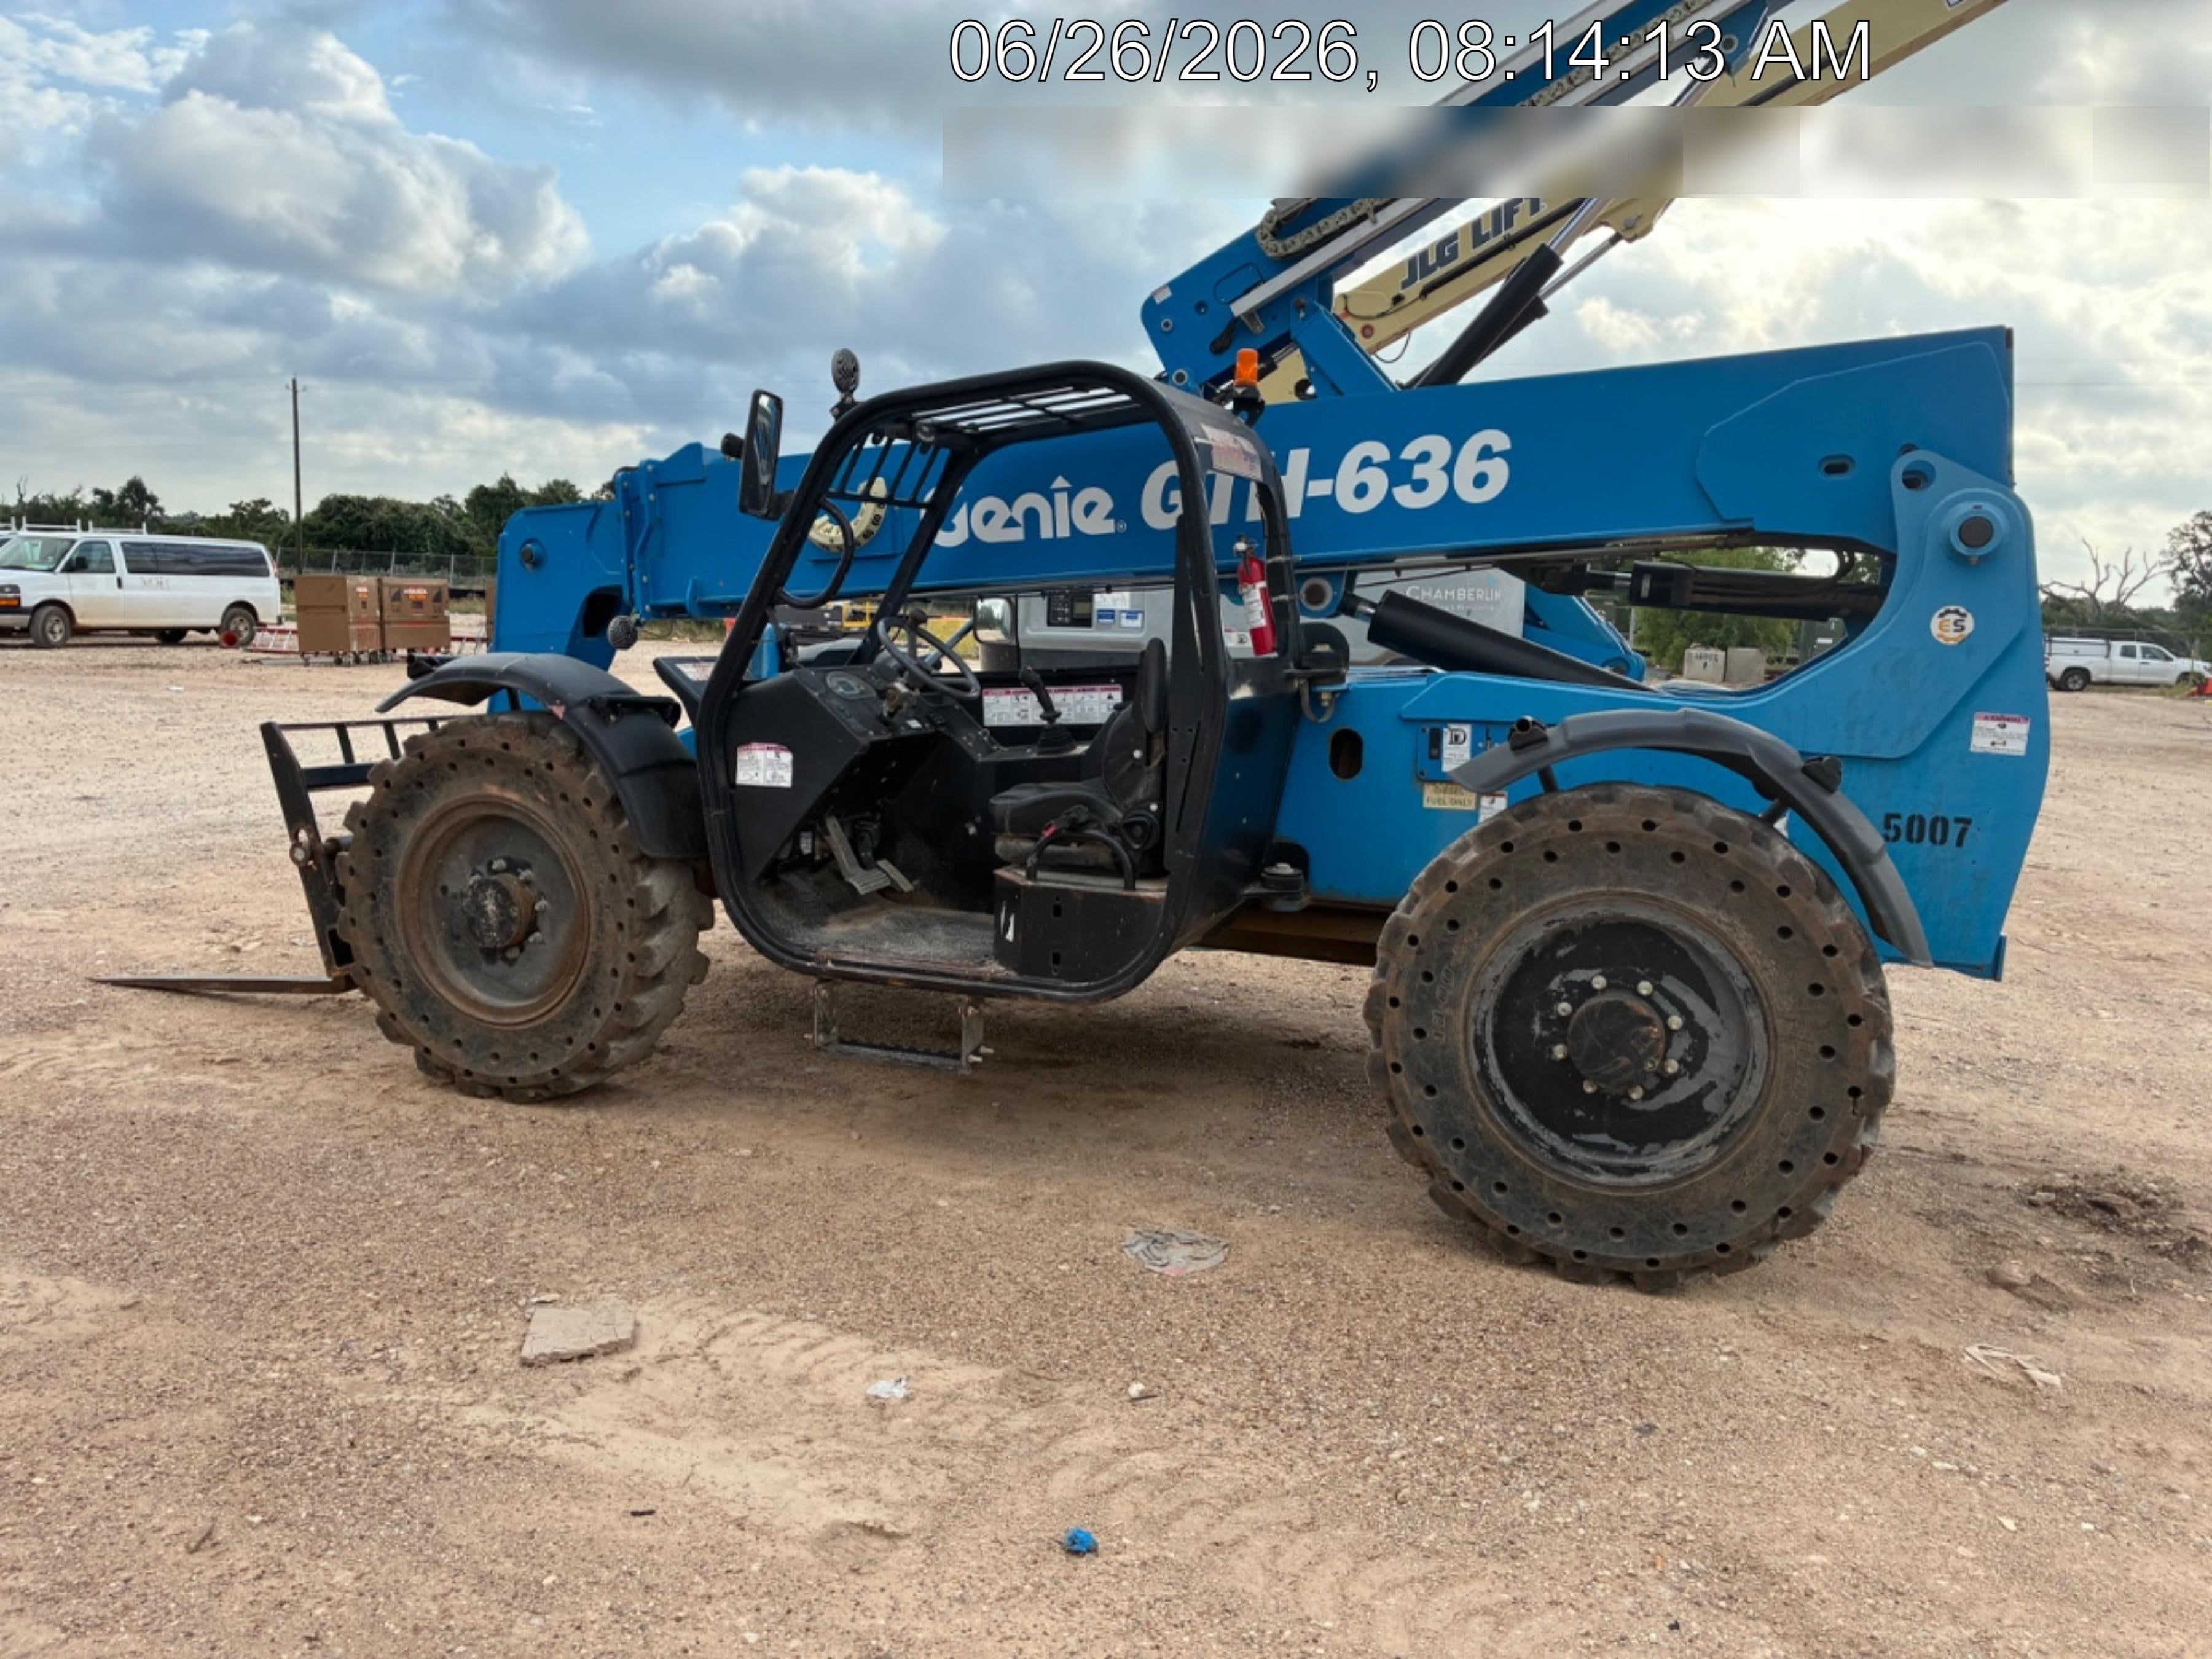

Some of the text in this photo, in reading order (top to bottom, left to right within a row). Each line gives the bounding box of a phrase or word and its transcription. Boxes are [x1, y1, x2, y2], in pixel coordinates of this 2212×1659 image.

[1400, 231, 1459, 291] JLG
[1406, 586, 1501, 600] CHAMBERLIN
[1939, 619, 1966, 633] ES
[1426, 796, 1473, 807] FUEL ONLY
[1882, 812, 1973, 848] 5007
